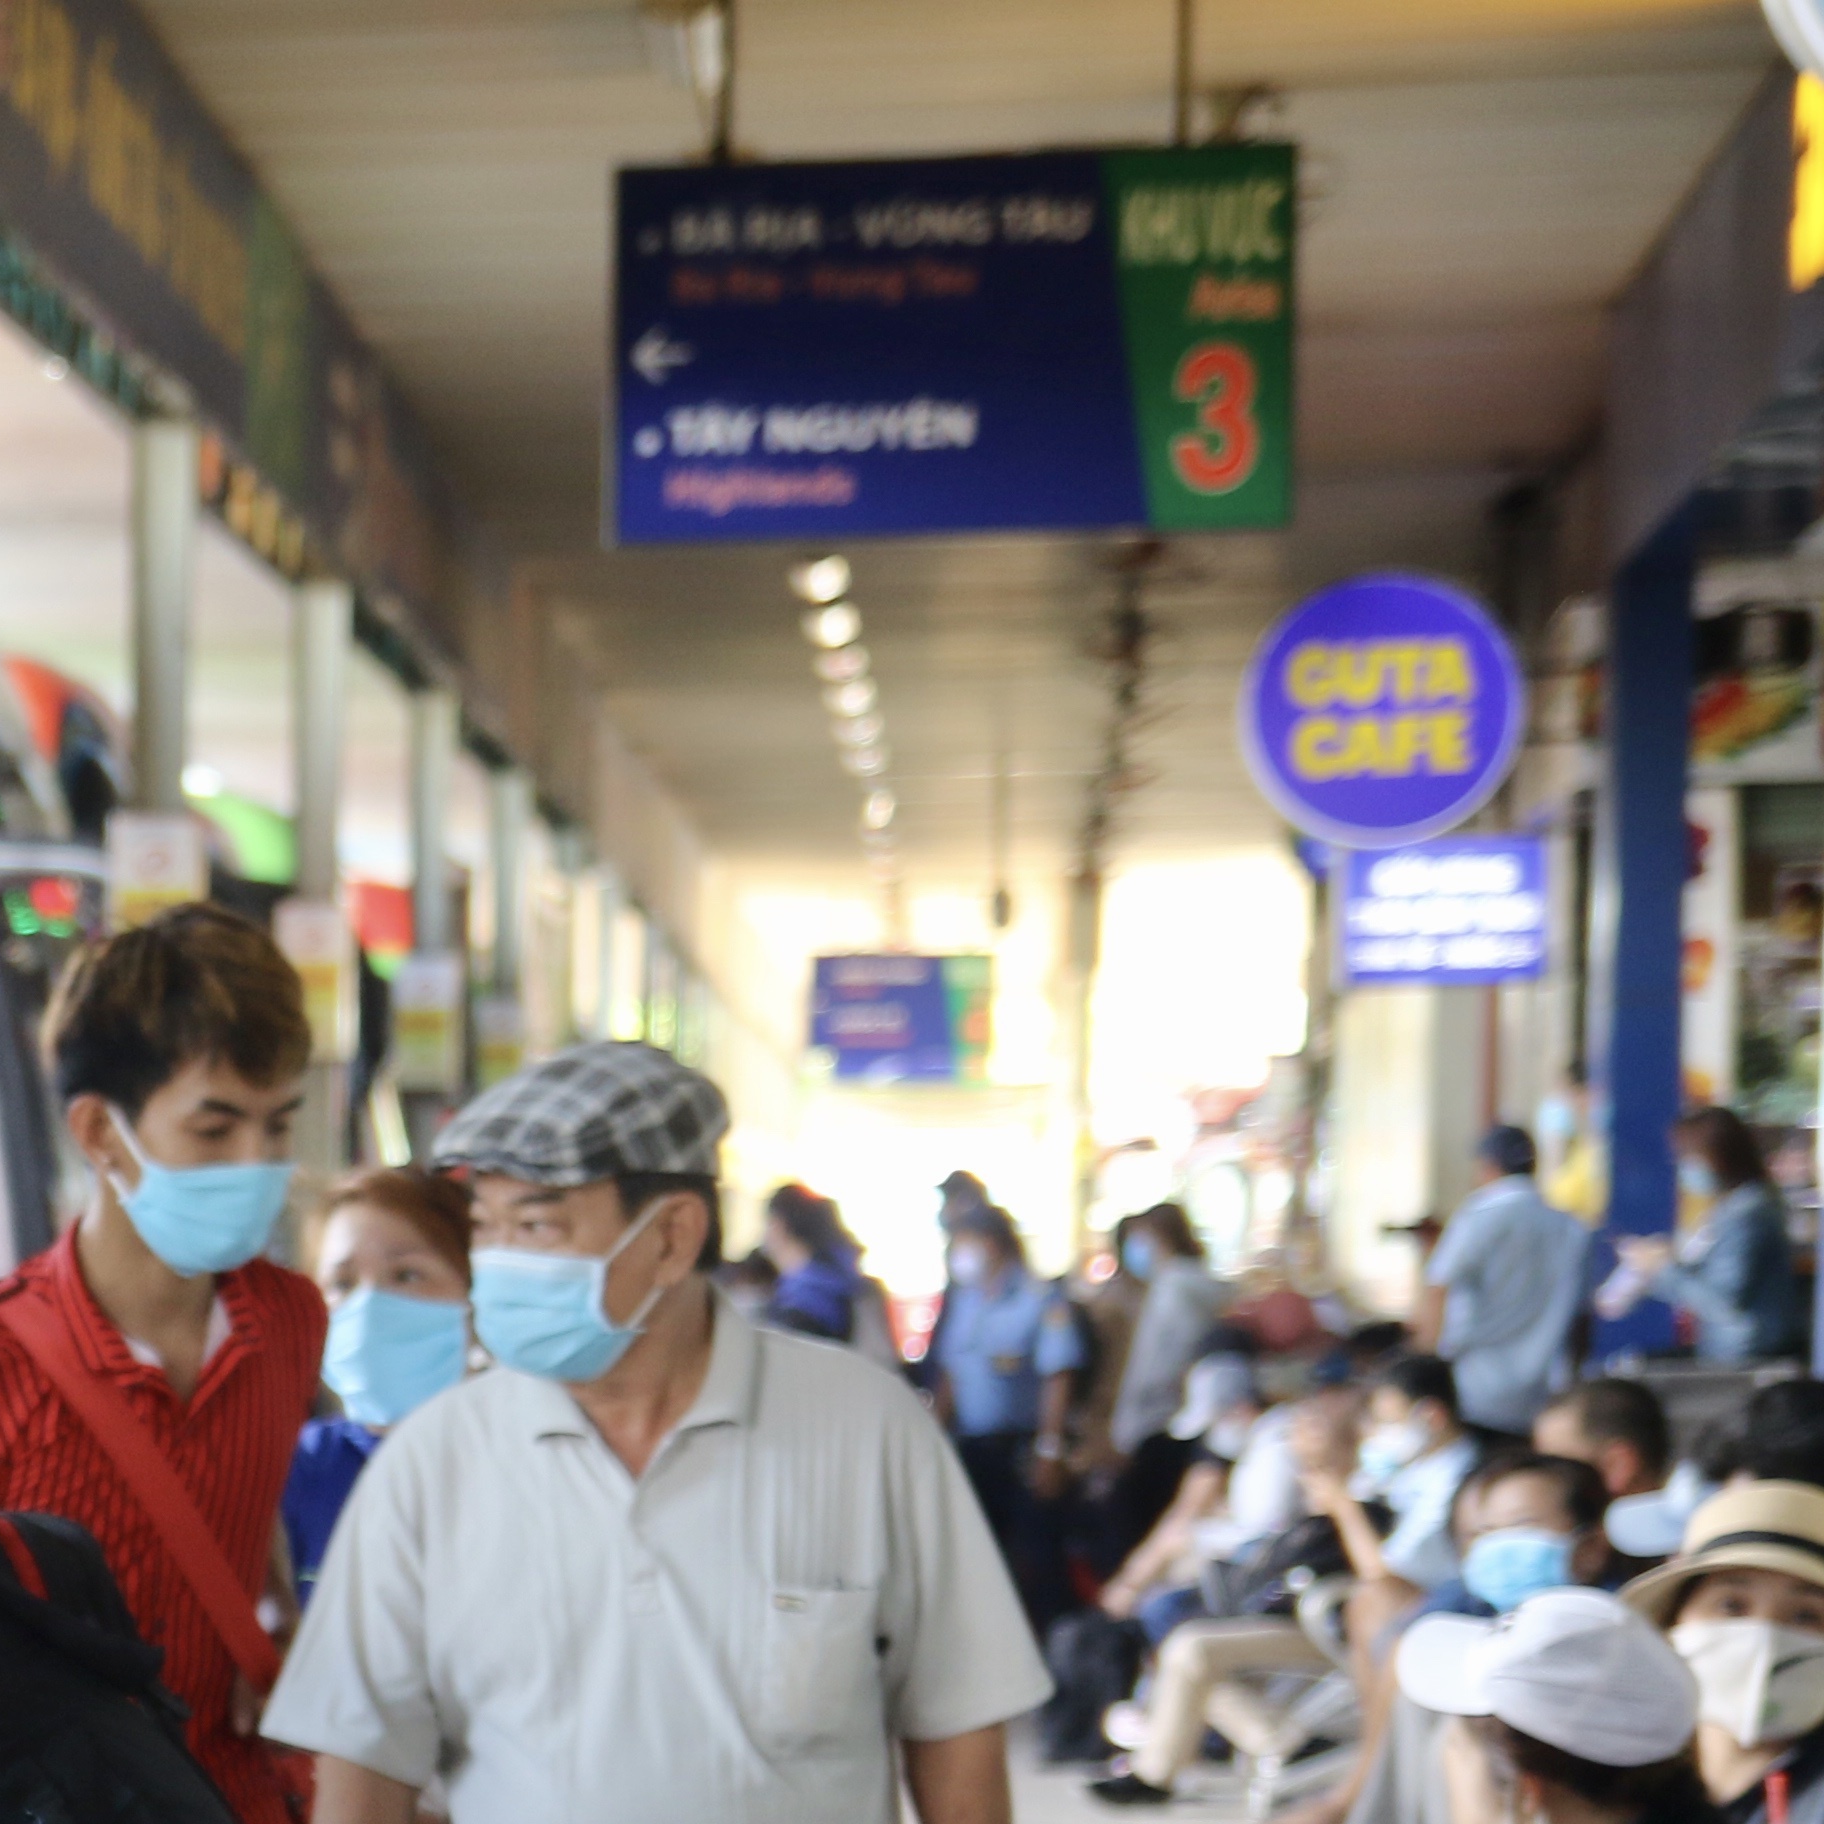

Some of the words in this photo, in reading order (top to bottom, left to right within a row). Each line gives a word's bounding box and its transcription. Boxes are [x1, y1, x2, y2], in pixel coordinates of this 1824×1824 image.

[1168, 340, 1260, 496] 3
[1287, 640, 1473, 709] GUTA
[1292, 711, 1472, 783] CAFE
